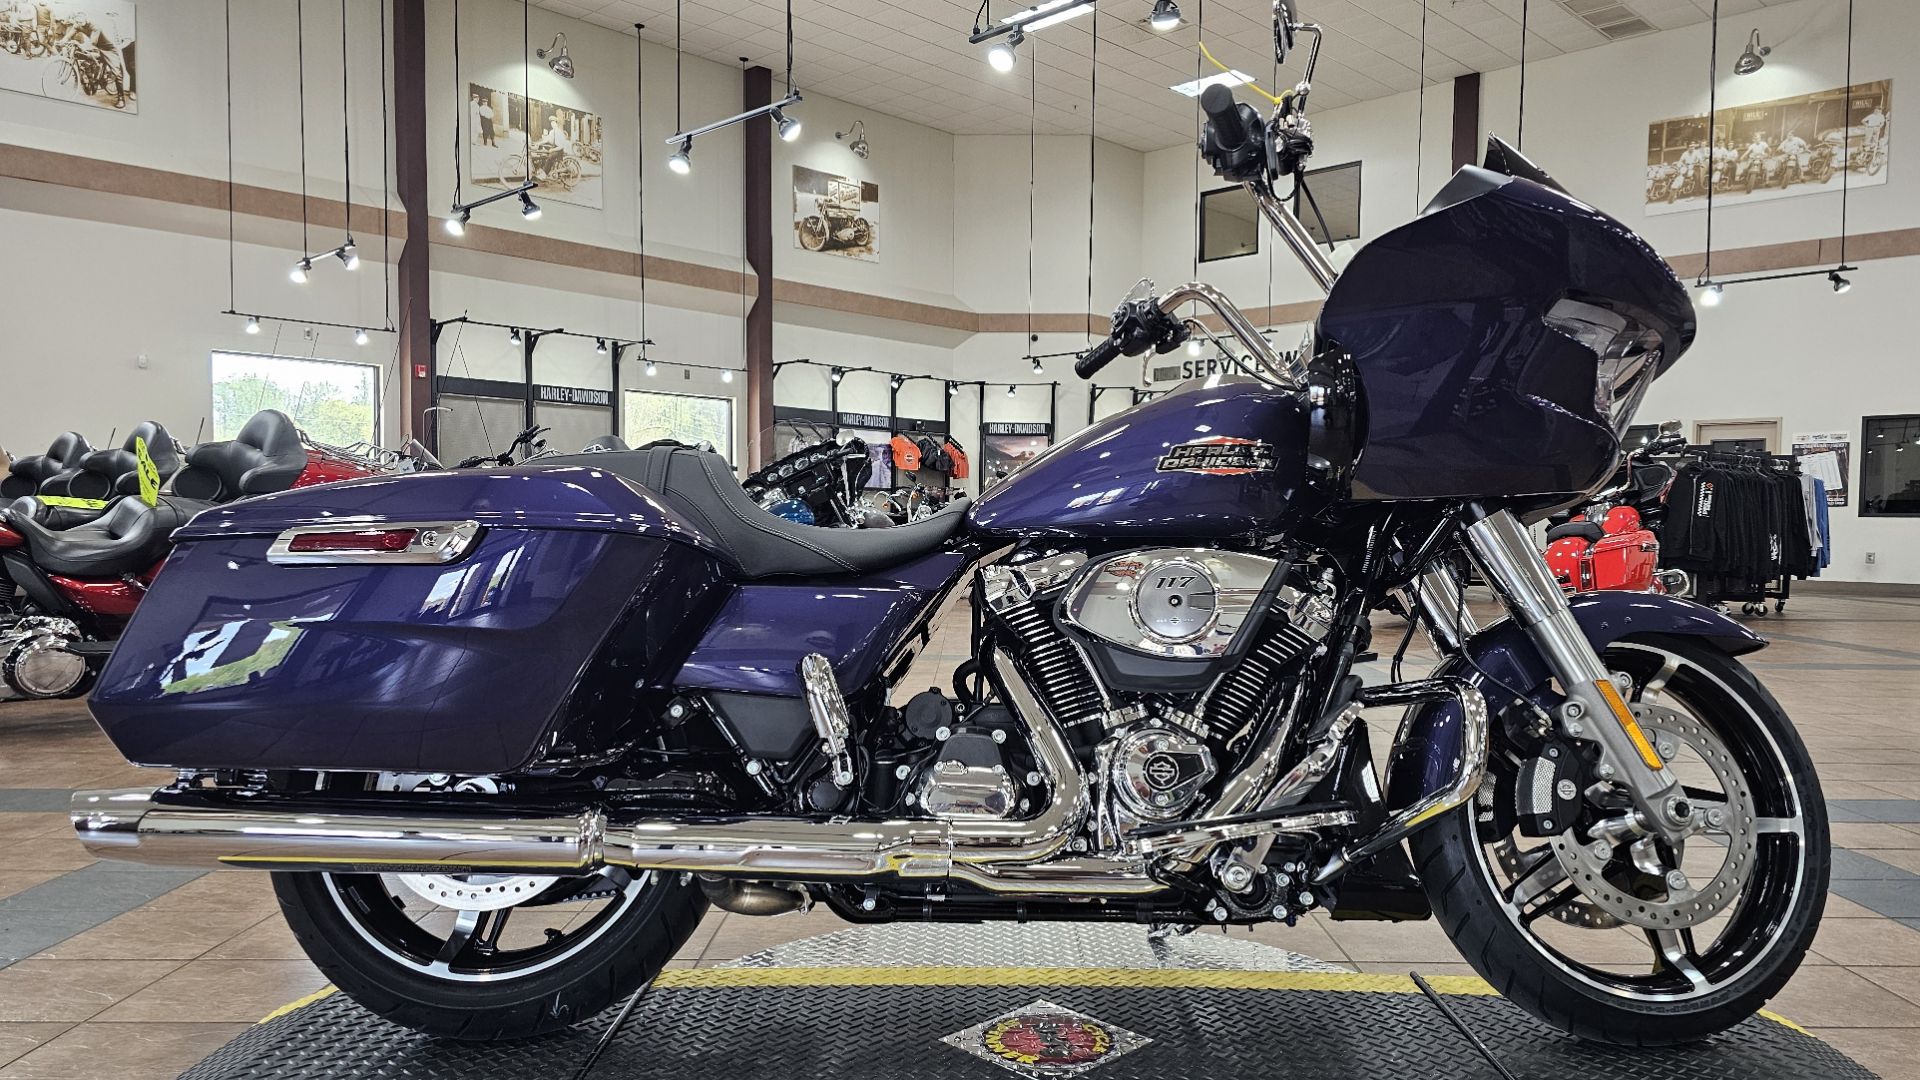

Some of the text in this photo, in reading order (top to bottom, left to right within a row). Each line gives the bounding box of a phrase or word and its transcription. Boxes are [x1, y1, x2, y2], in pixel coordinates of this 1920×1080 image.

[540, 386, 609, 405] HARLEY-DAVIDSON
[842, 413, 890, 428] HARLEY-DAVIDSON
[989, 423, 1047, 434] HARLEY-DAVIDSON
[1155, 576, 1197, 589] 117
